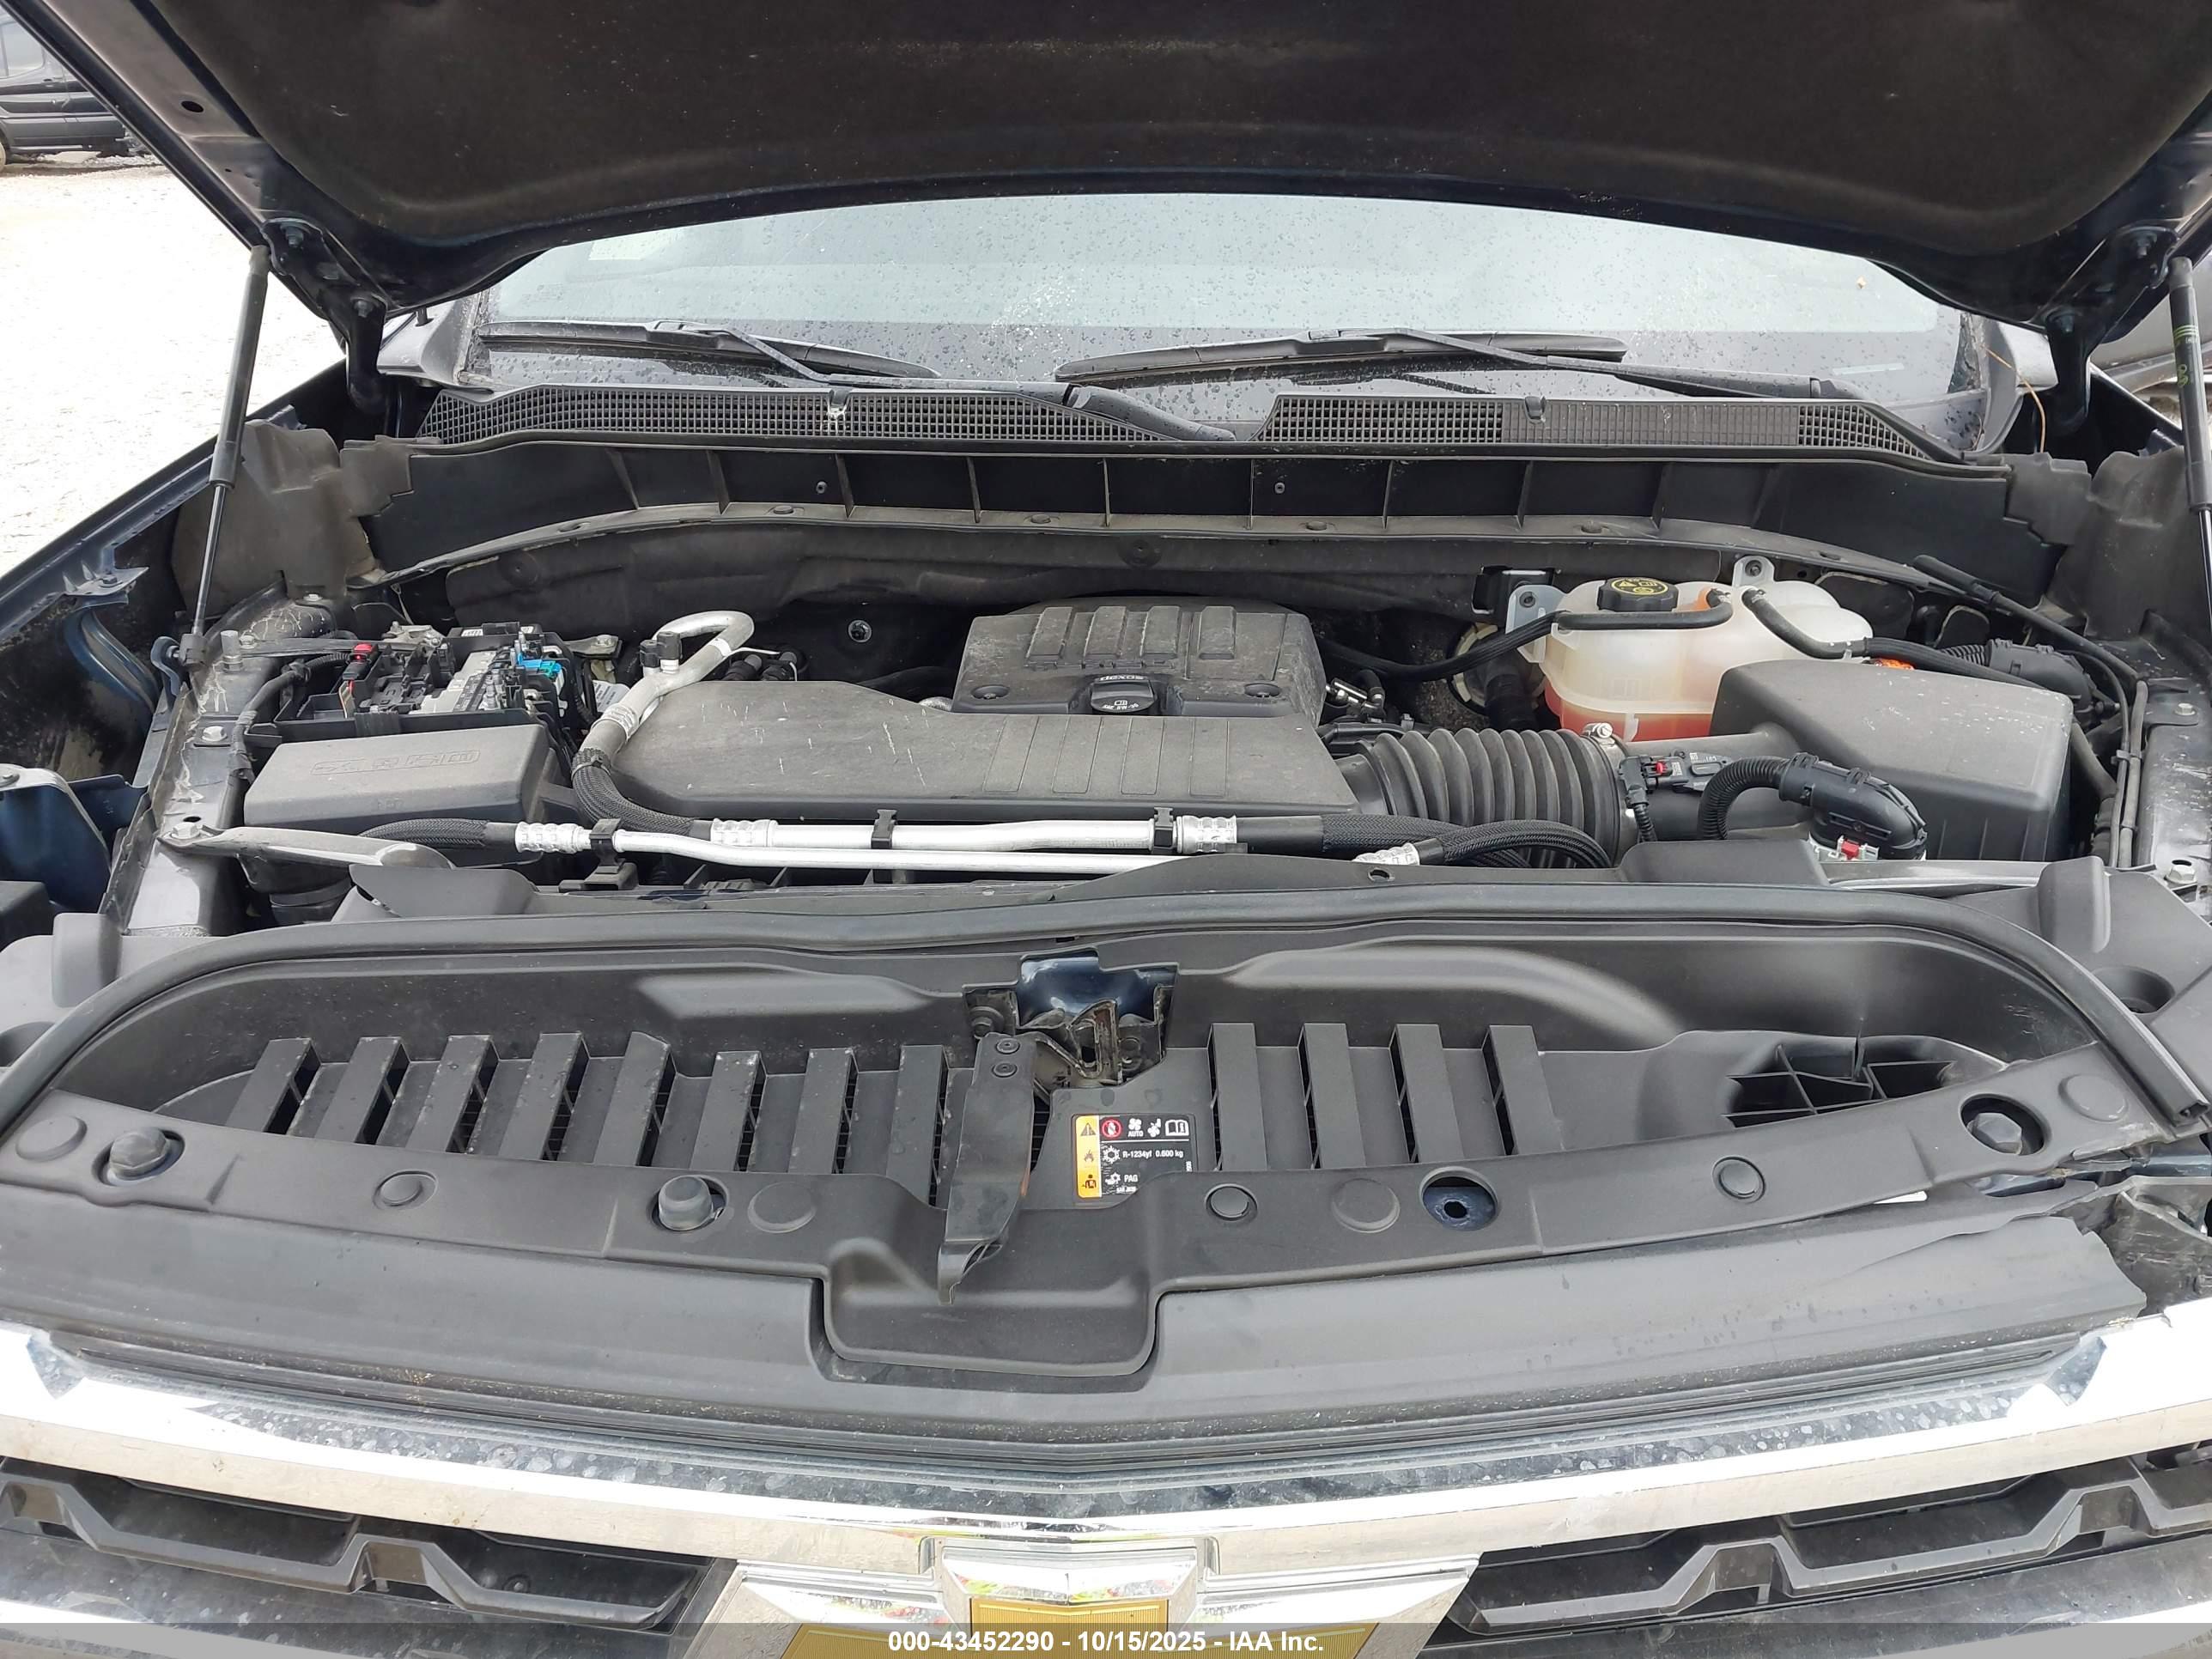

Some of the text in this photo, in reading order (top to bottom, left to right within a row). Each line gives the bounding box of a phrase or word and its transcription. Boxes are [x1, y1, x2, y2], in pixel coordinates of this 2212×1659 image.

[1122, 1150, 1152, 1159] R-1234yf
[1175, 1149, 1184, 1158] kg
[1124, 1174, 1139, 1183] PAG
